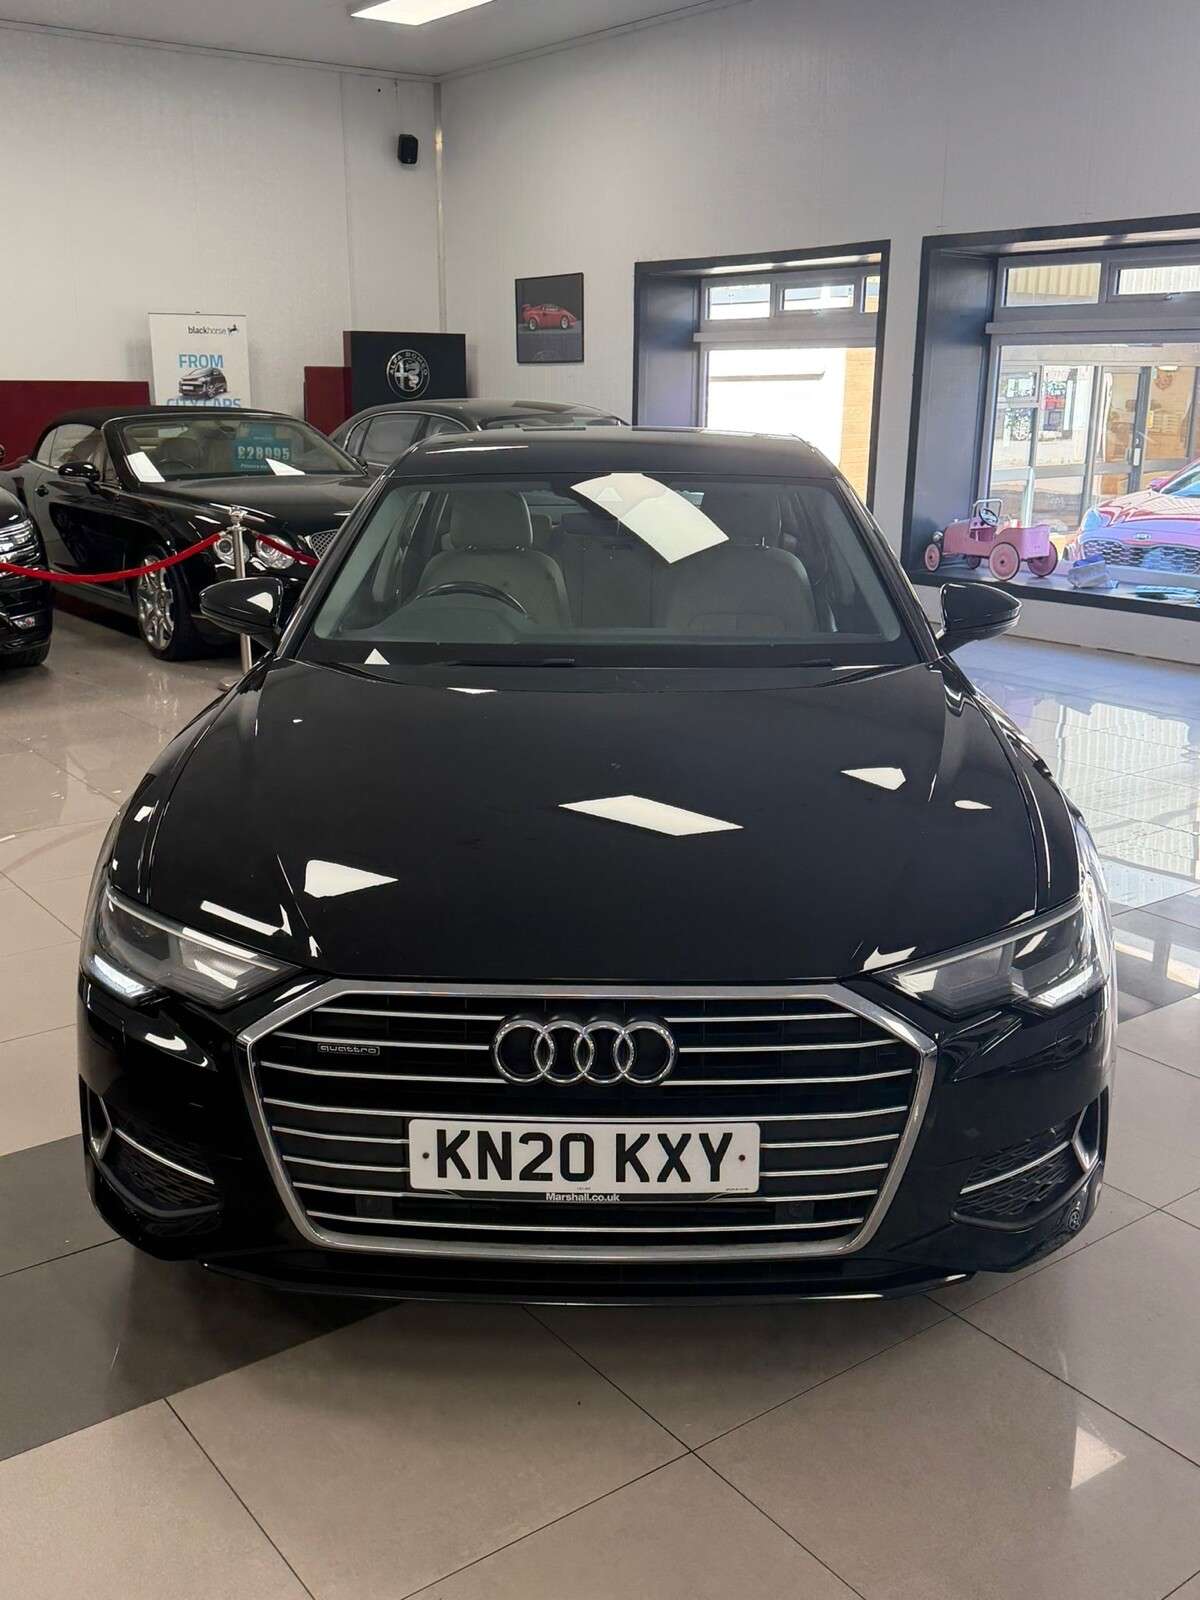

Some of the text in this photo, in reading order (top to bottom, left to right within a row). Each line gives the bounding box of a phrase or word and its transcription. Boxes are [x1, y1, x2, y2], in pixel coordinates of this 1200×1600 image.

[187, 326, 226, 335] blackhorse
[178, 353, 223, 369] FROM
[320, 1045, 377, 1054] quattro
[436, 1128, 733, 1183] KN20 KXY
[545, 1192, 621, 1203] Marshall.co.uk
